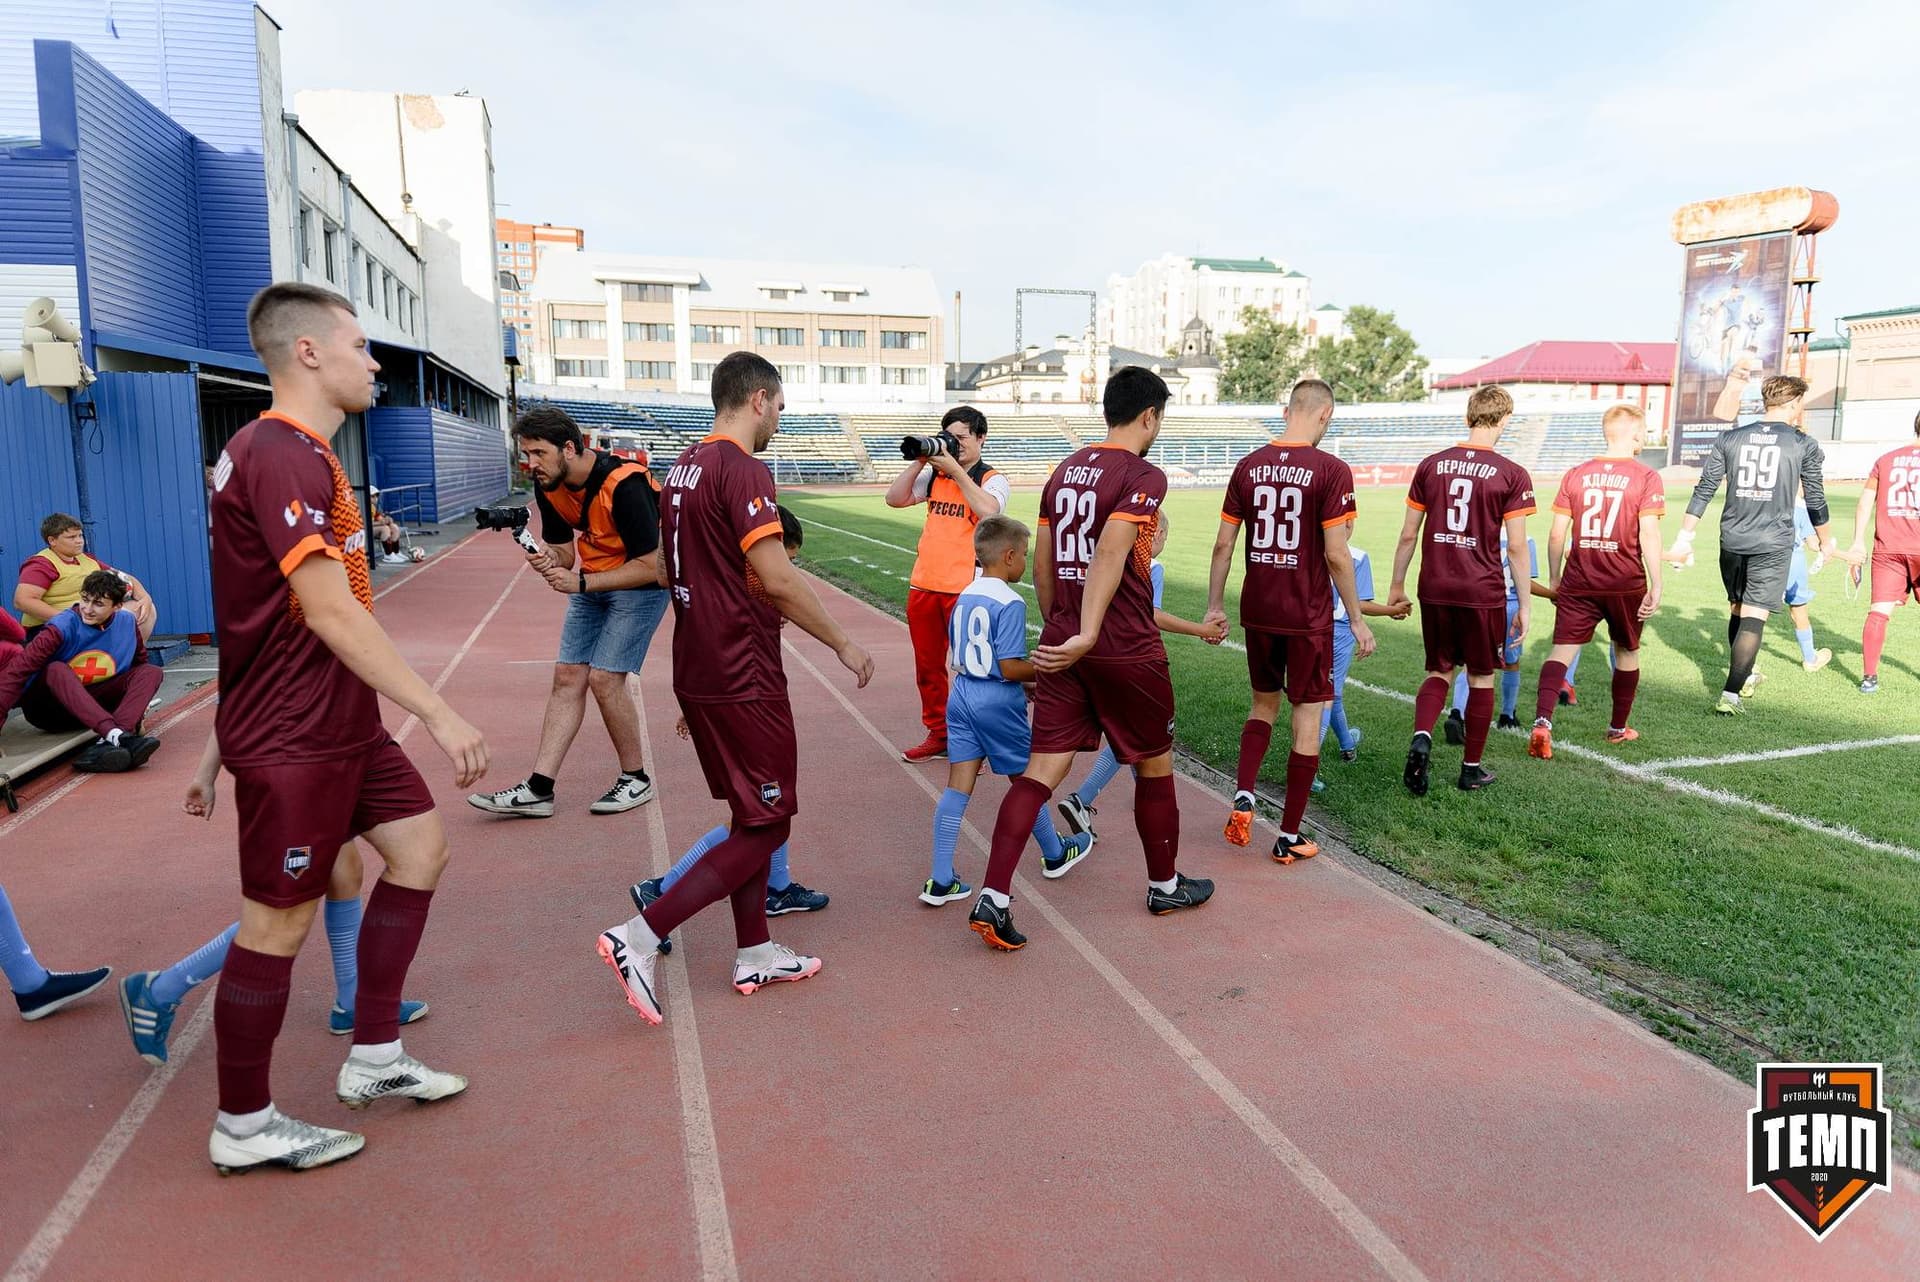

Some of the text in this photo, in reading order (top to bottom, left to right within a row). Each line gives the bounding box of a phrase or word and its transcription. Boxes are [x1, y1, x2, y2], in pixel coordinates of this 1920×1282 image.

[1249, 465, 1313, 487] ЧЕРКАСОВ
[1436, 459, 1498, 480] ВЕРНИГОР
[1737, 445, 1781, 489] 59
[1582, 473, 1630, 490] ЖДАНОВ
[1735, 489, 1773, 498] SEUS
[1446, 478, 1473, 532] 3
[1580, 488, 1624, 538] 27
[1055, 488, 1097, 563] 22
[1252, 485, 1303, 550] 33
[1433, 533, 1477, 547] SEUS
[1579, 540, 1618, 549] SEUS
[1250, 552, 1298, 566] SEUS
[1058, 567, 1088, 580] SEU
[952, 605, 993, 678] 18
